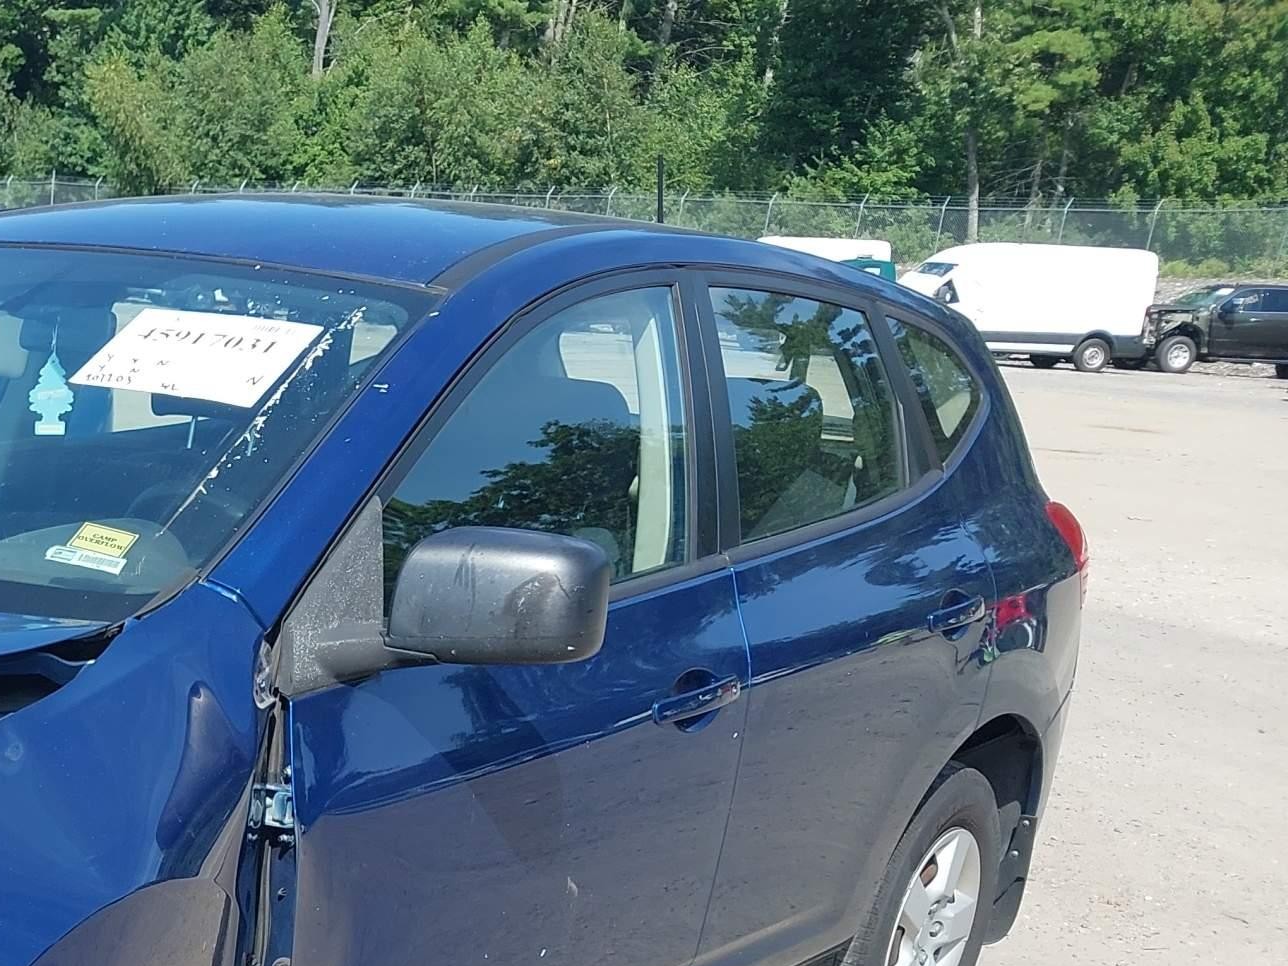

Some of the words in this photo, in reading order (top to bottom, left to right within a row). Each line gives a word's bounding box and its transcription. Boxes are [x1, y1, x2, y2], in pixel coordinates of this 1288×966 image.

[137, 327, 279, 354] 45917031
[78, 535, 126, 550] OVERFLOW
[92, 533, 118, 543] CAMP
